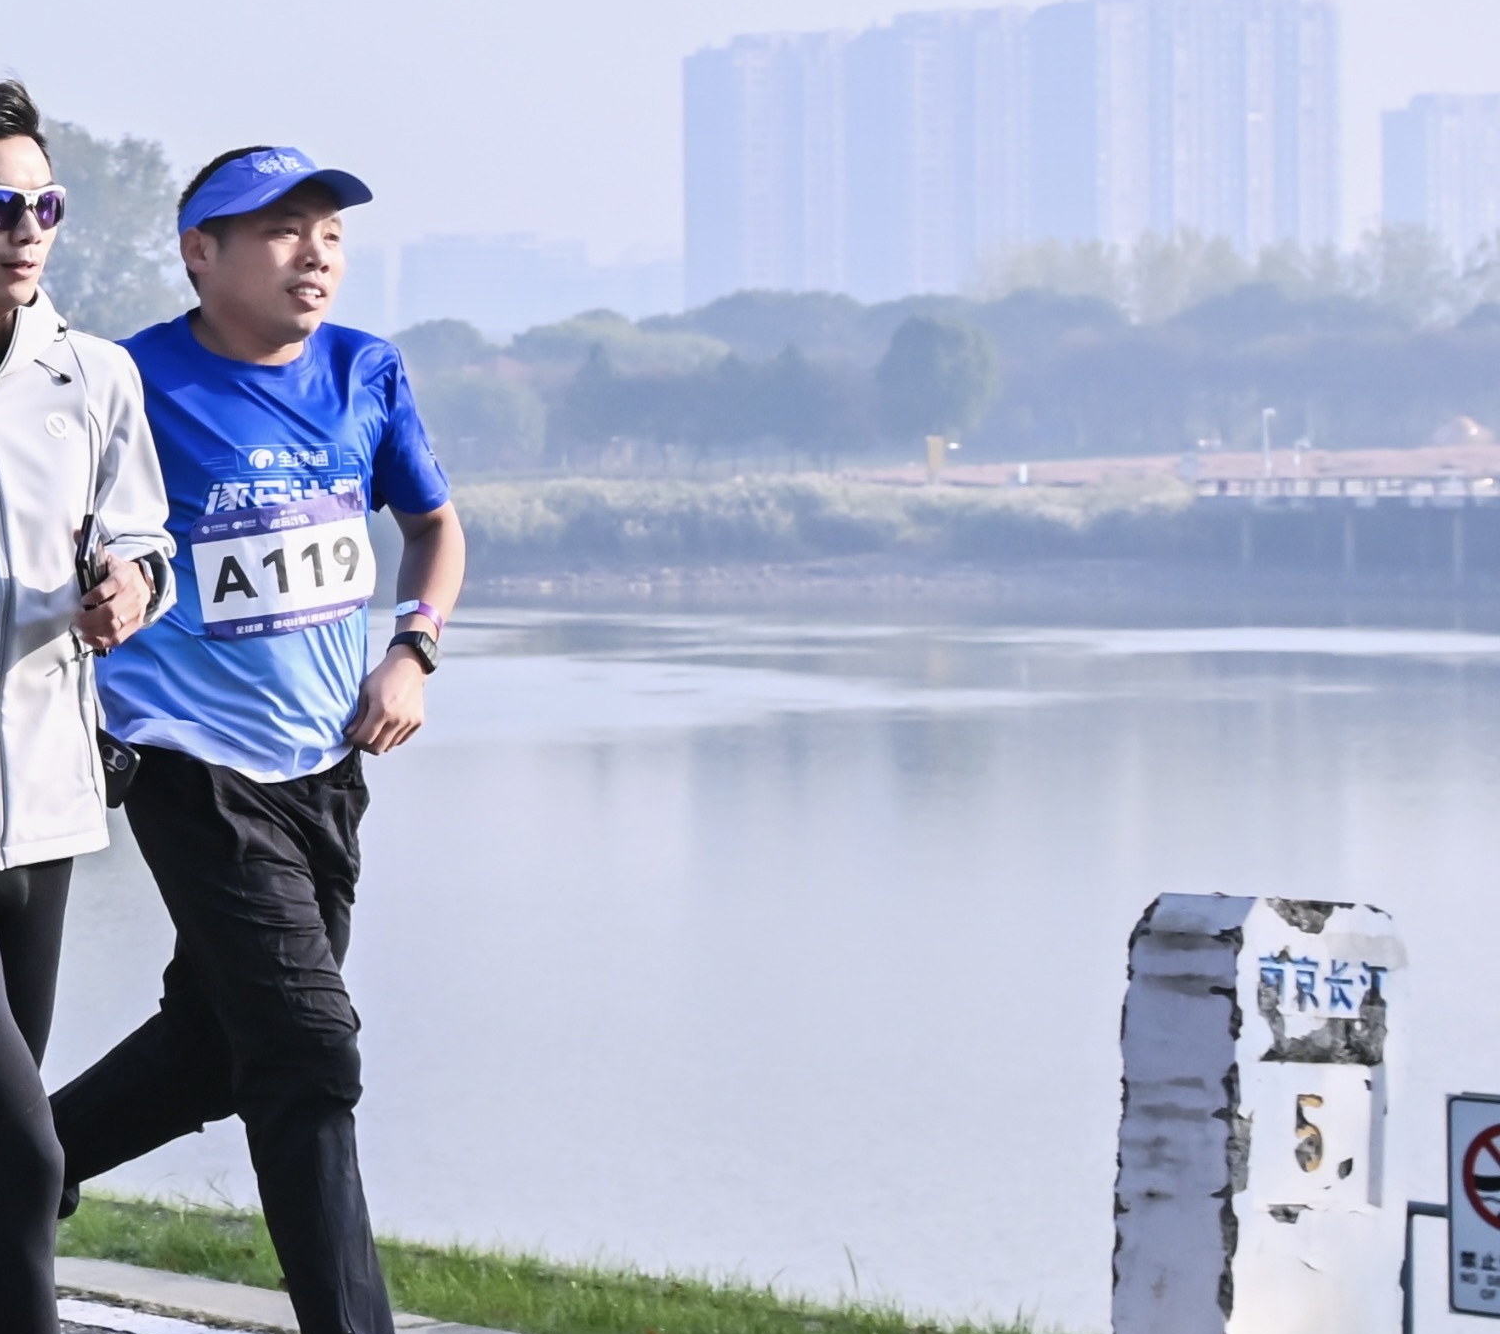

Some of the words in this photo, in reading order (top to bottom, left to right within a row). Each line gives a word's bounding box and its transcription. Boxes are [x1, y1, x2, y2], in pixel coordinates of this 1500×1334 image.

[278, 450, 329, 468] 全球通
[213, 536, 360, 603] A119
[1294, 1093, 1324, 1173] 5
